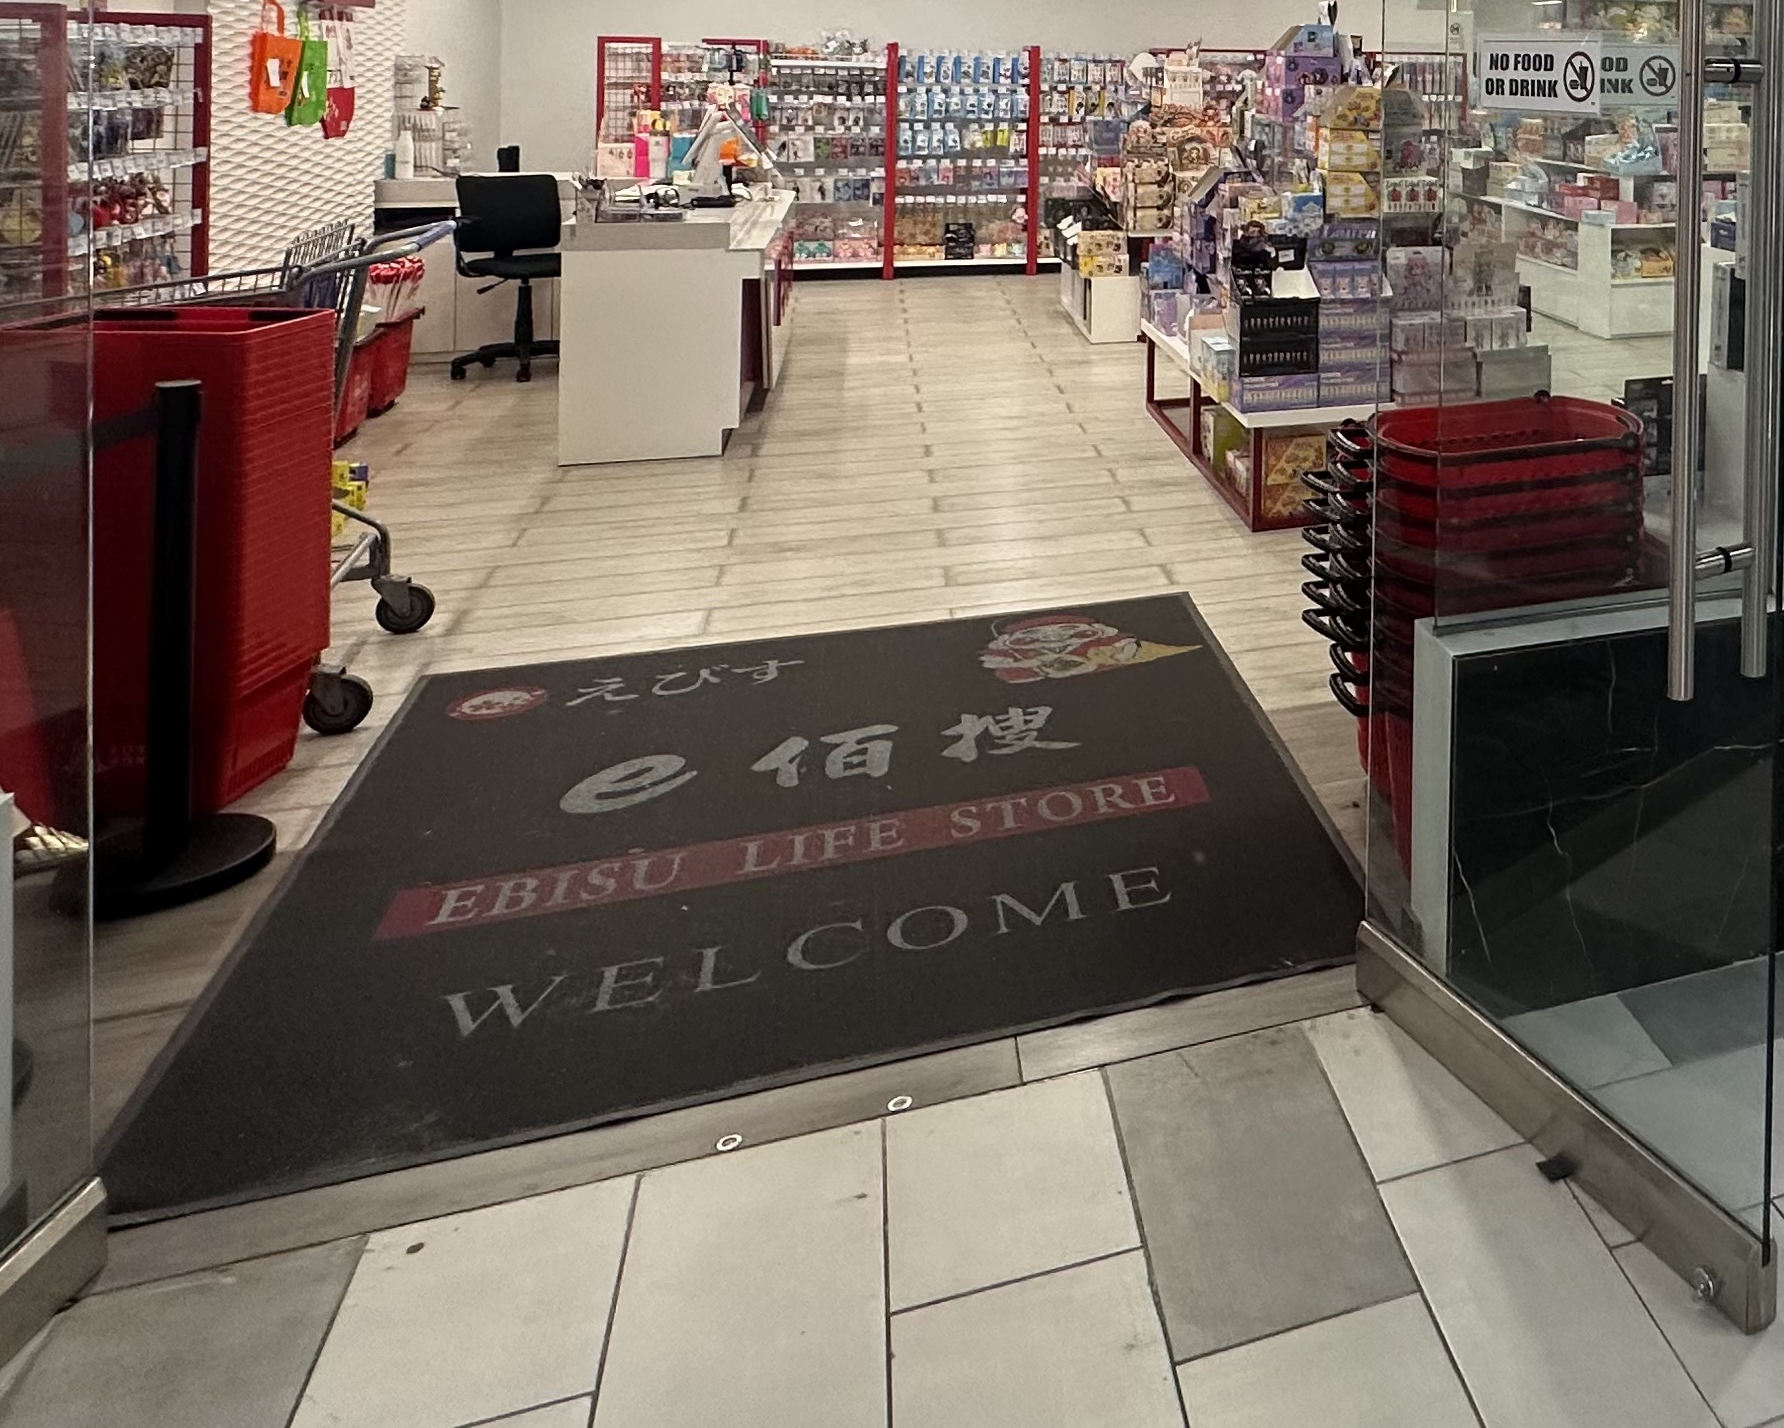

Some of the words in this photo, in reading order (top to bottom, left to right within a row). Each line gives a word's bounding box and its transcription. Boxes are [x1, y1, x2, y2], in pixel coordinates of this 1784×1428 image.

[1489, 53, 1510, 72] NO
[1513, 53, 1555, 72] FOOD
[1600, 57, 1629, 73] OD
[1485, 78, 1506, 96] OR
[1509, 79, 1559, 98] DRINK
[1600, 78, 1634, 94] INK
[564, 658, 806, 707] えびす
[424, 852, 685, 927] EBISU
[738, 816, 907, 875] LIFE
[946, 776, 1179, 842] STORE
[441, 866, 1175, 1041] WELCOME
